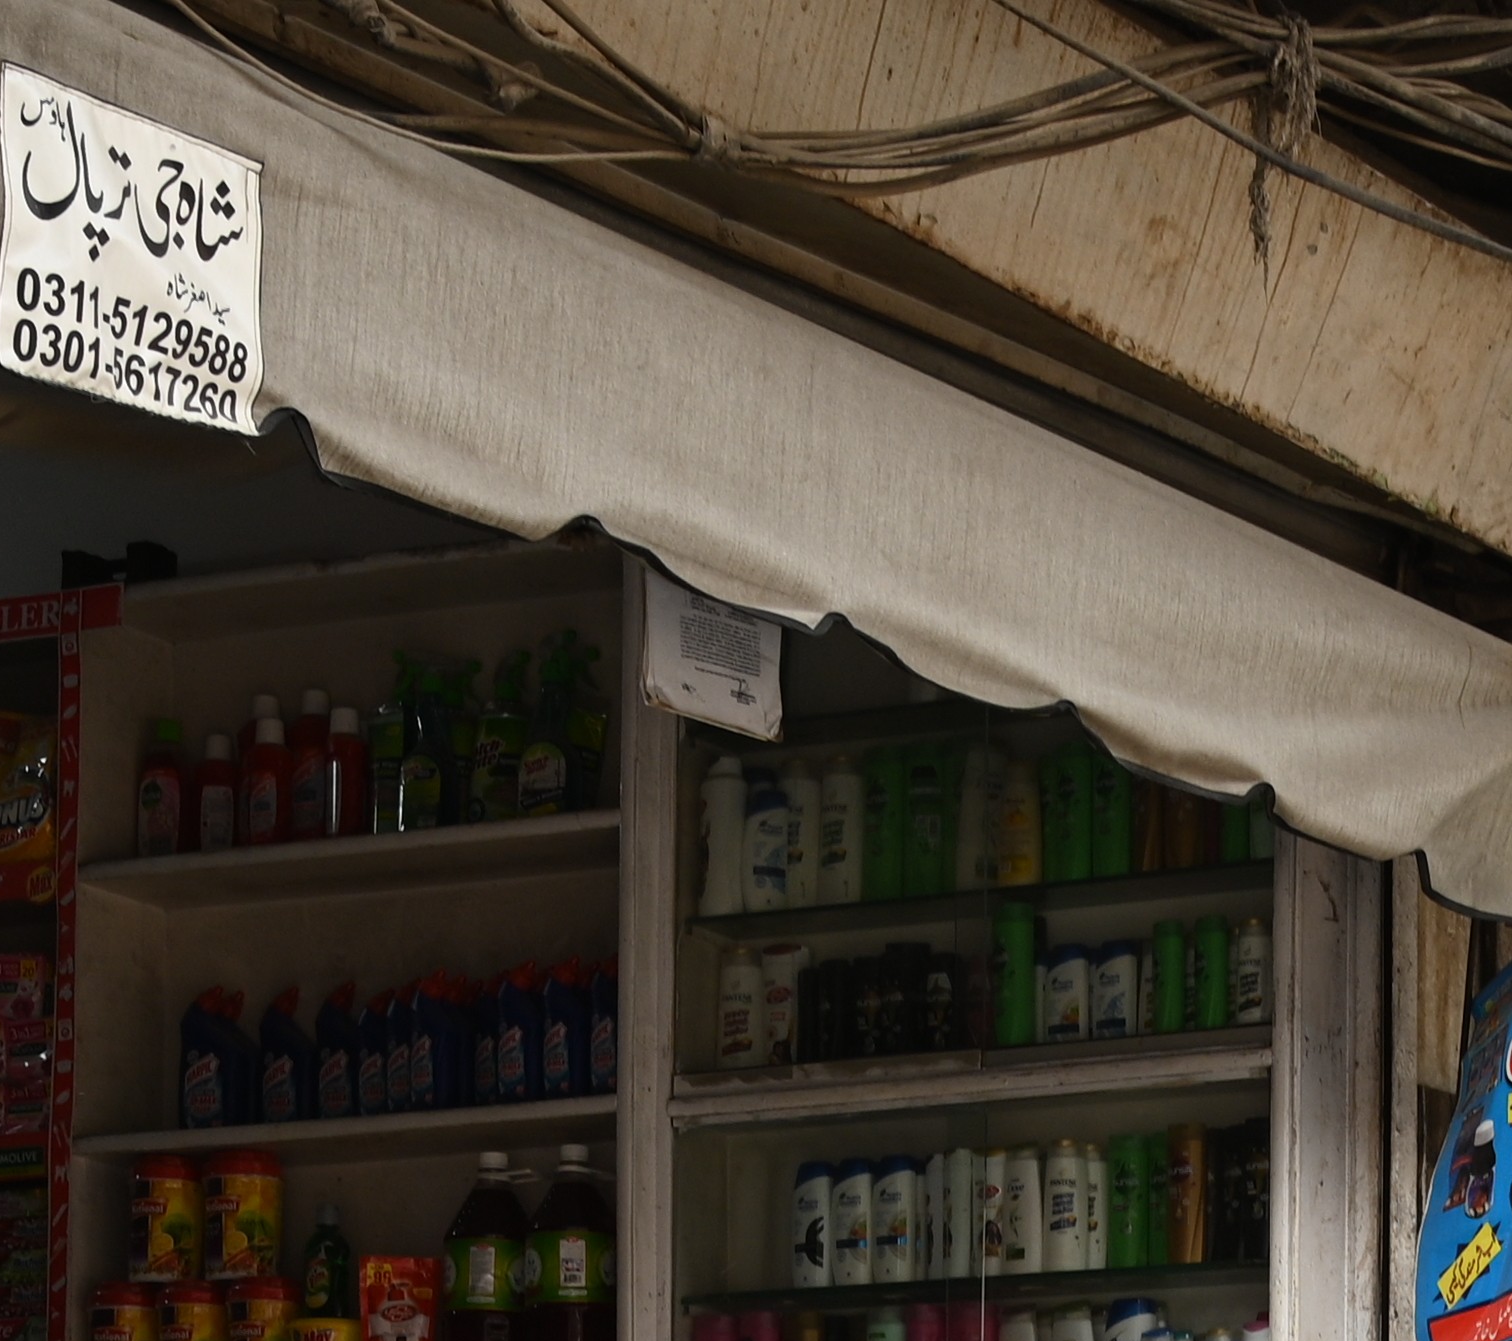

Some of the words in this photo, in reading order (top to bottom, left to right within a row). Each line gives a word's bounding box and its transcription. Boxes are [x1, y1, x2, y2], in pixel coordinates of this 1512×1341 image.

[22, 100, 131, 261] ترپال
[134, 158, 185, 258] جی
[176, 179, 244, 261] شاہ
[13, 319, 238, 423] 0301-5617260
[17, 267, 248, 383] 0311-5129588
